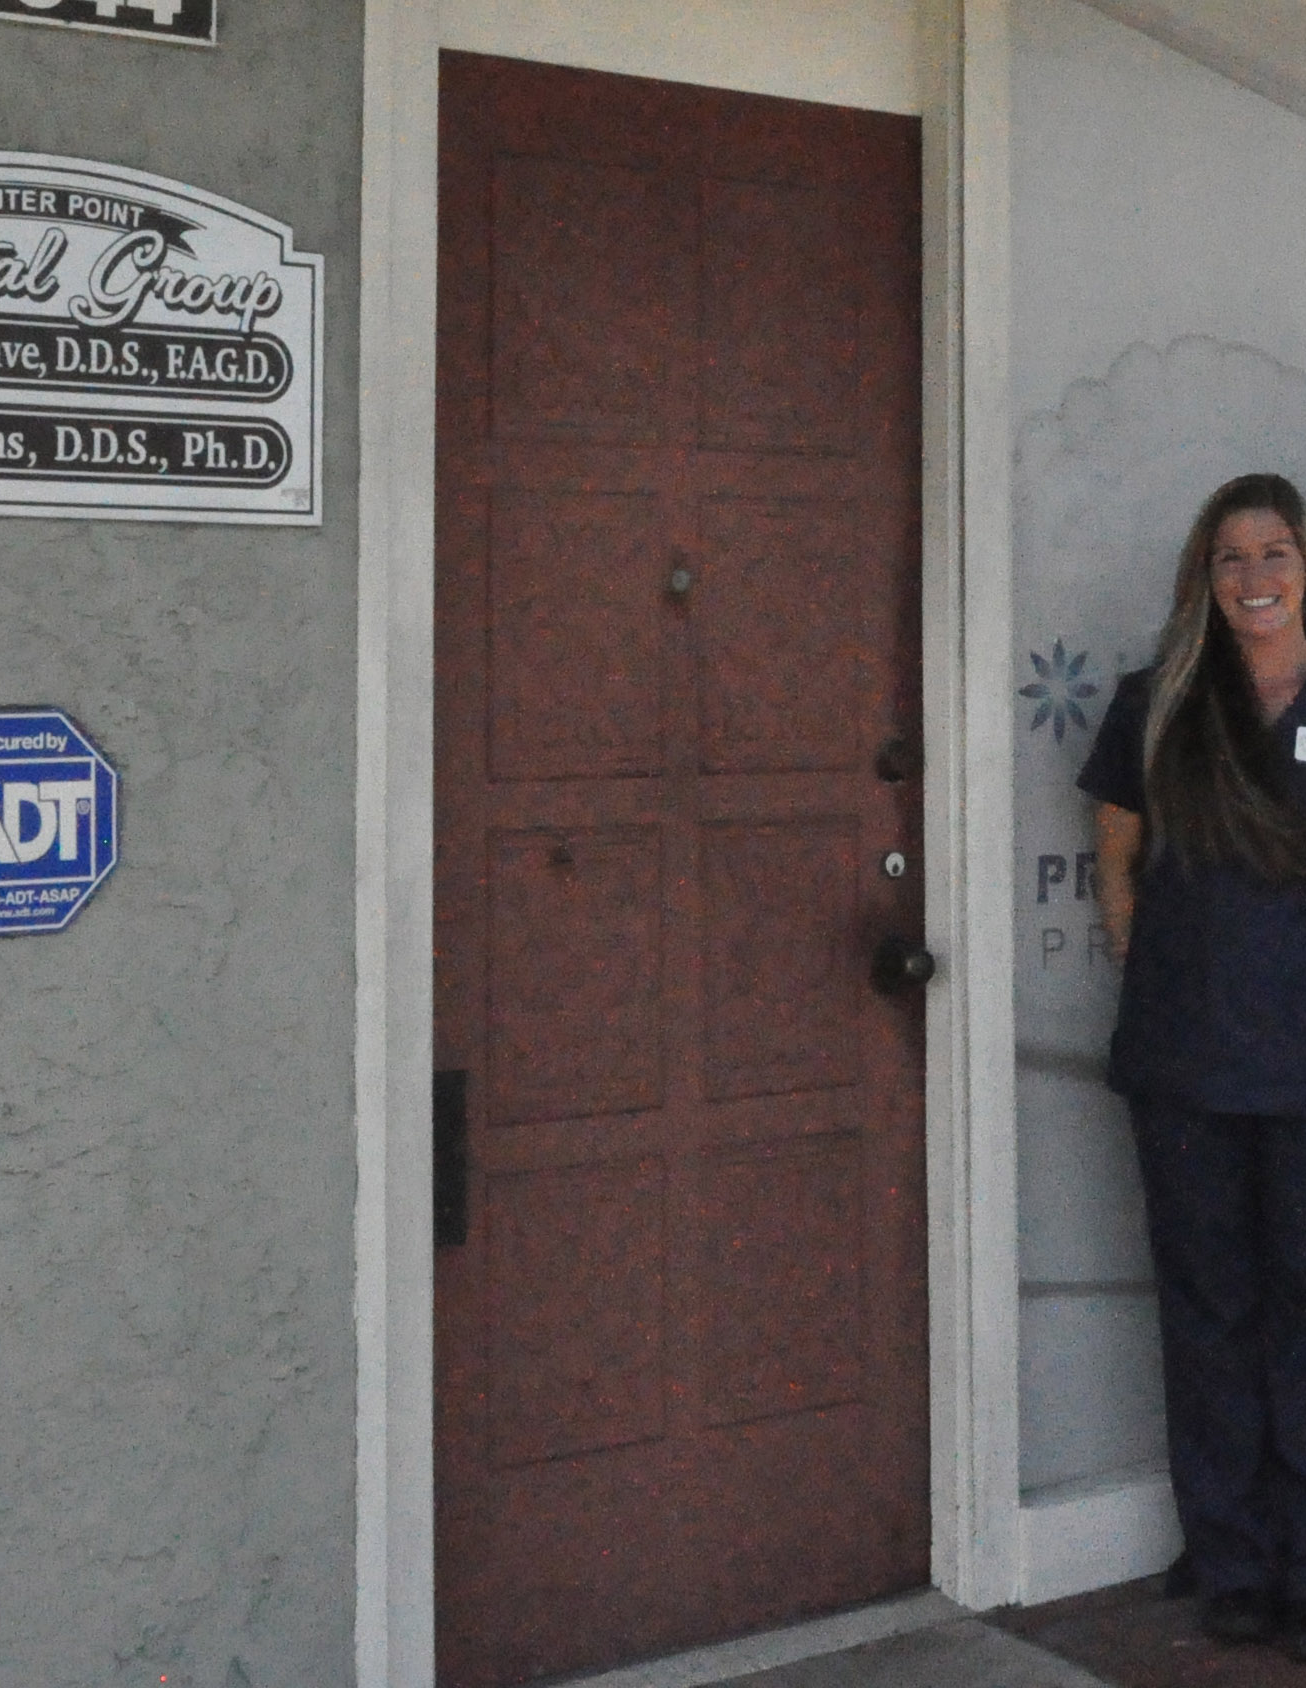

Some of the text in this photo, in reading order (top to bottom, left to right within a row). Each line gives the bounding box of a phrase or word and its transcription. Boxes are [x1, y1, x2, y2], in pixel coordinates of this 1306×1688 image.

[67, 194, 145, 229] POINT
[68, 229, 283, 333] Group
[55, 336, 160, 385] D.D.S.,
[166, 344, 276, 385] F.A.G.D.
[53, 425, 169, 474] D.D.S.,
[181, 430, 277, 470] Ph.D.
[45, 732, 69, 753] by
